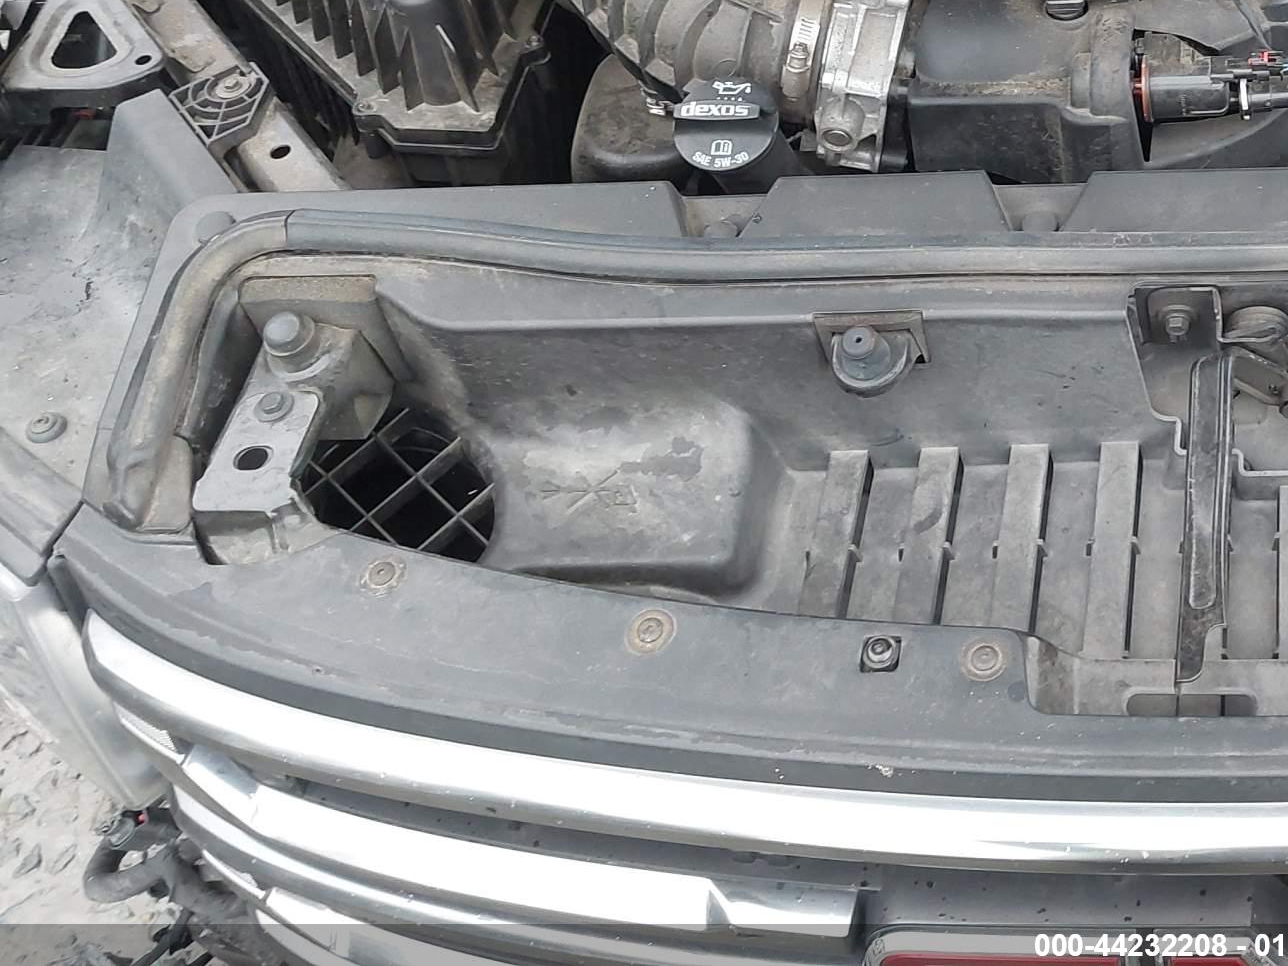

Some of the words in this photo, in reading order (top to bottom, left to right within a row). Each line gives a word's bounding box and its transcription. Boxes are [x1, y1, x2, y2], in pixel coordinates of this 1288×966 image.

[680, 101, 751, 117] dexos
[692, 152, 712, 167] SAE
[714, 151, 749, 168] 5W-30
